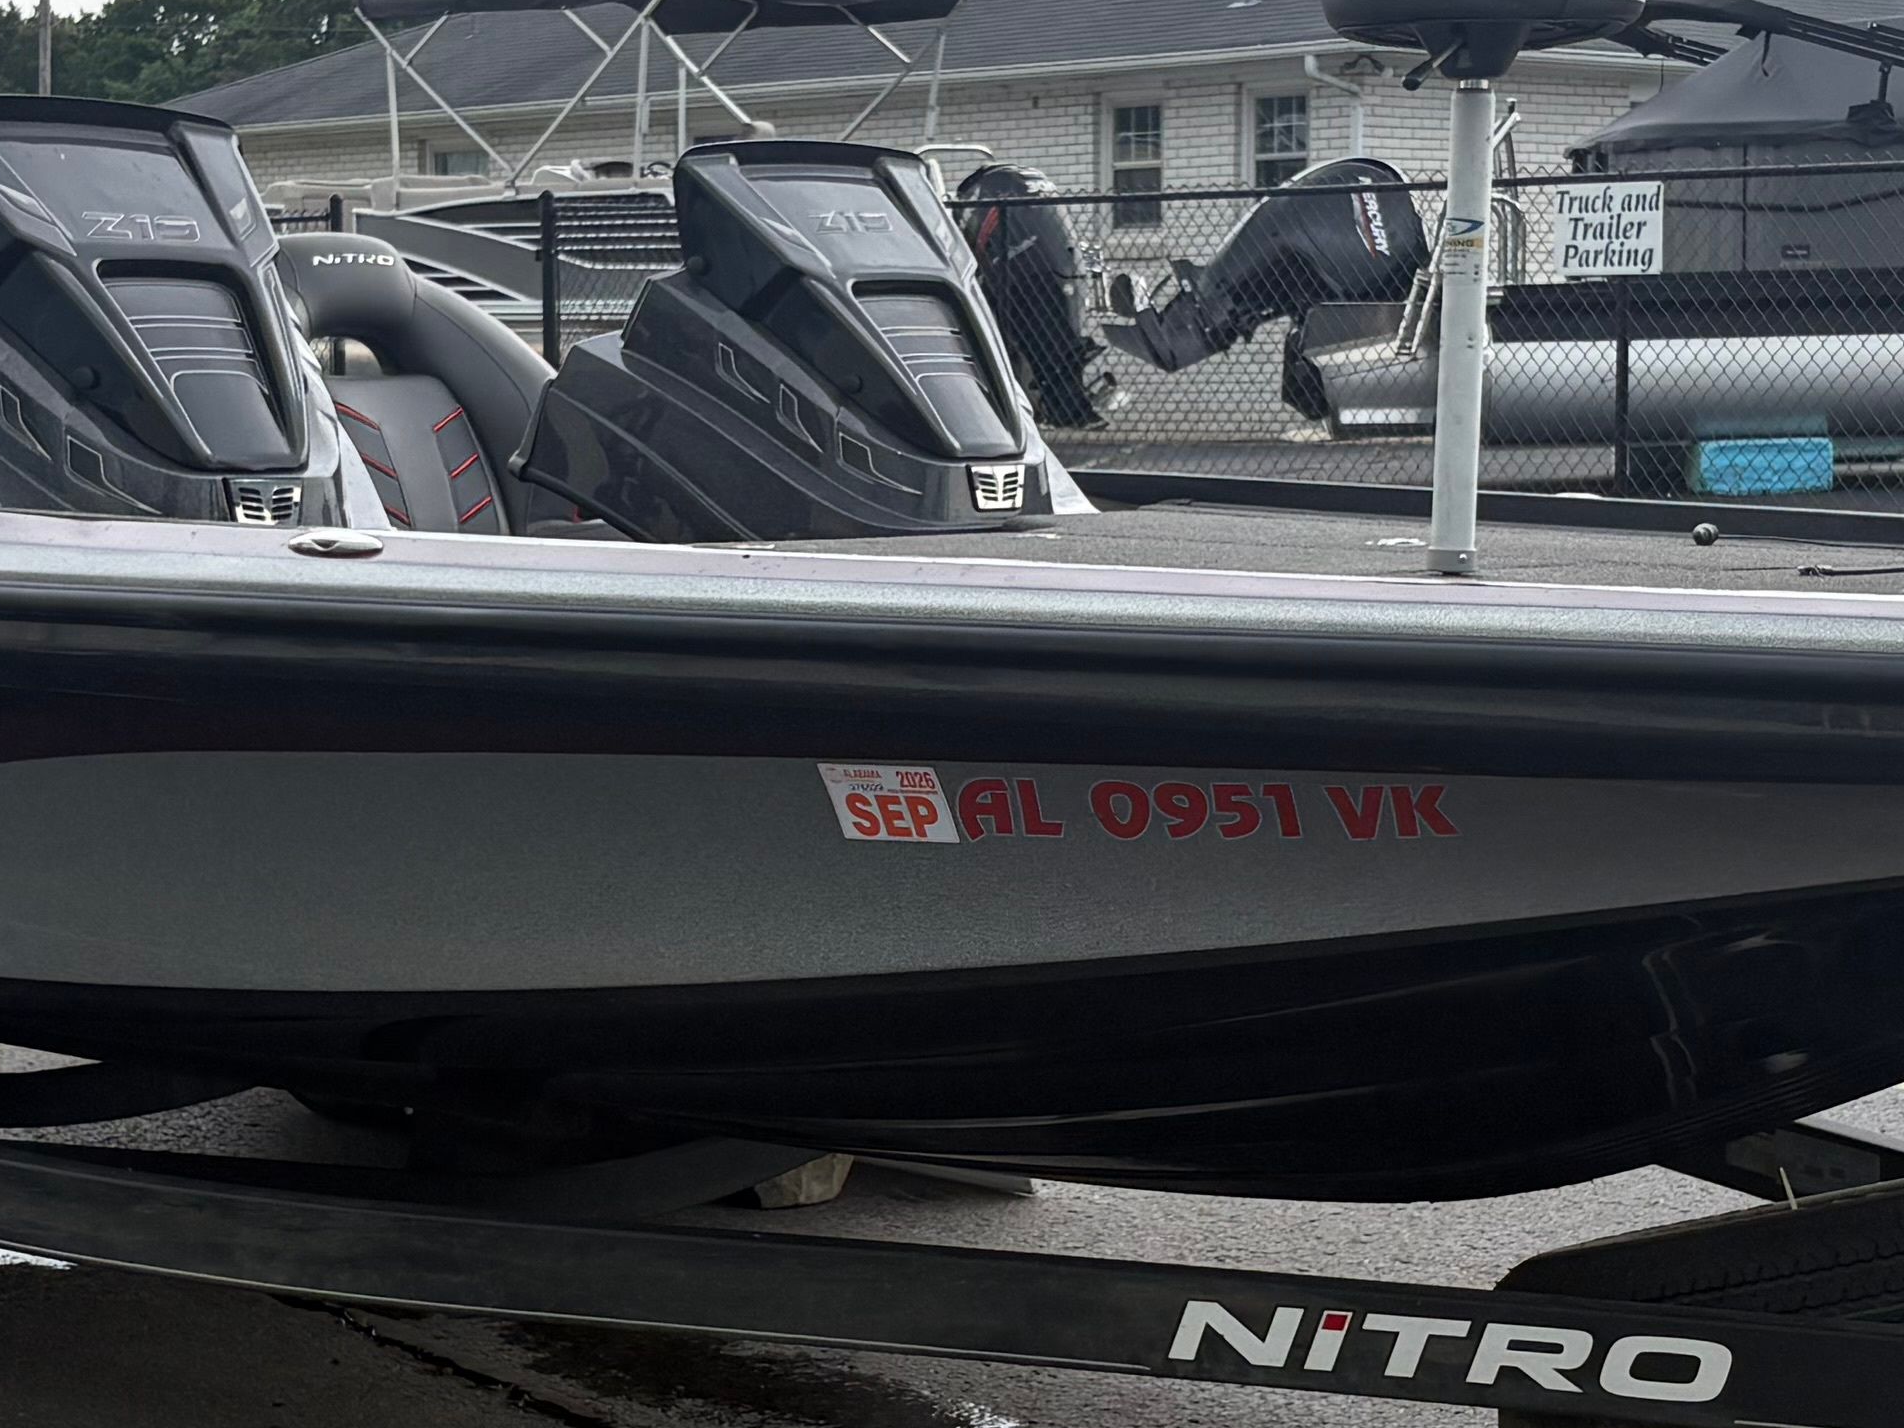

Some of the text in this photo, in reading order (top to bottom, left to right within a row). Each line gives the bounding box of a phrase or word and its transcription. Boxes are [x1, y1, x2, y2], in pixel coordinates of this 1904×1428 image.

[1556, 184, 1662, 214] Truck and
[1568, 213, 1648, 241] Trailer
[1562, 240, 1655, 273] Parking
[896, 771, 936, 790] 2026
[845, 792, 939, 838] SEP
[957, 779, 1460, 843] AL 0951 VK
